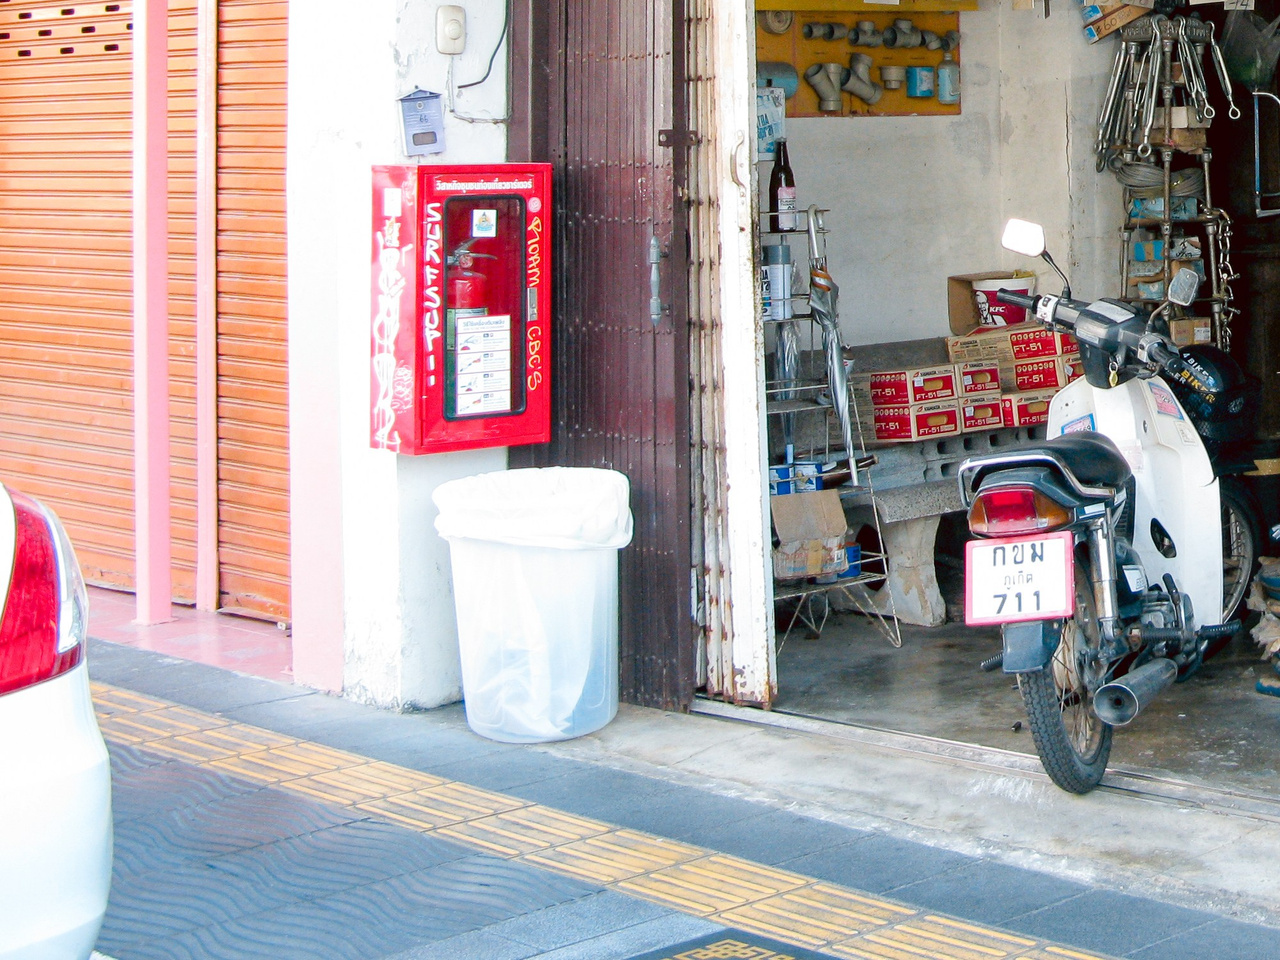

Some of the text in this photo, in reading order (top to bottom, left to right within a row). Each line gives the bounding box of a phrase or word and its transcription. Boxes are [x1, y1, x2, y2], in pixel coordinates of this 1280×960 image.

[1014, 342, 1043, 353] FT-51
[1017, 374, 1044, 385] FT-51
[871, 388, 896, 397] FT-51
[966, 384, 986, 392] FT-51
[916, 391, 937, 401] FT-51
[966, 419, 986, 427] FT-51
[1020, 416, 1040, 424] FT-51
[875, 422, 900, 430] FT-51
[919, 426, 941, 435] FT-51
[993, 542, 1044, 567] กขม
[1004, 570, 1033, 590] ภูเก็ต
[993, 590, 1040, 615] 711
